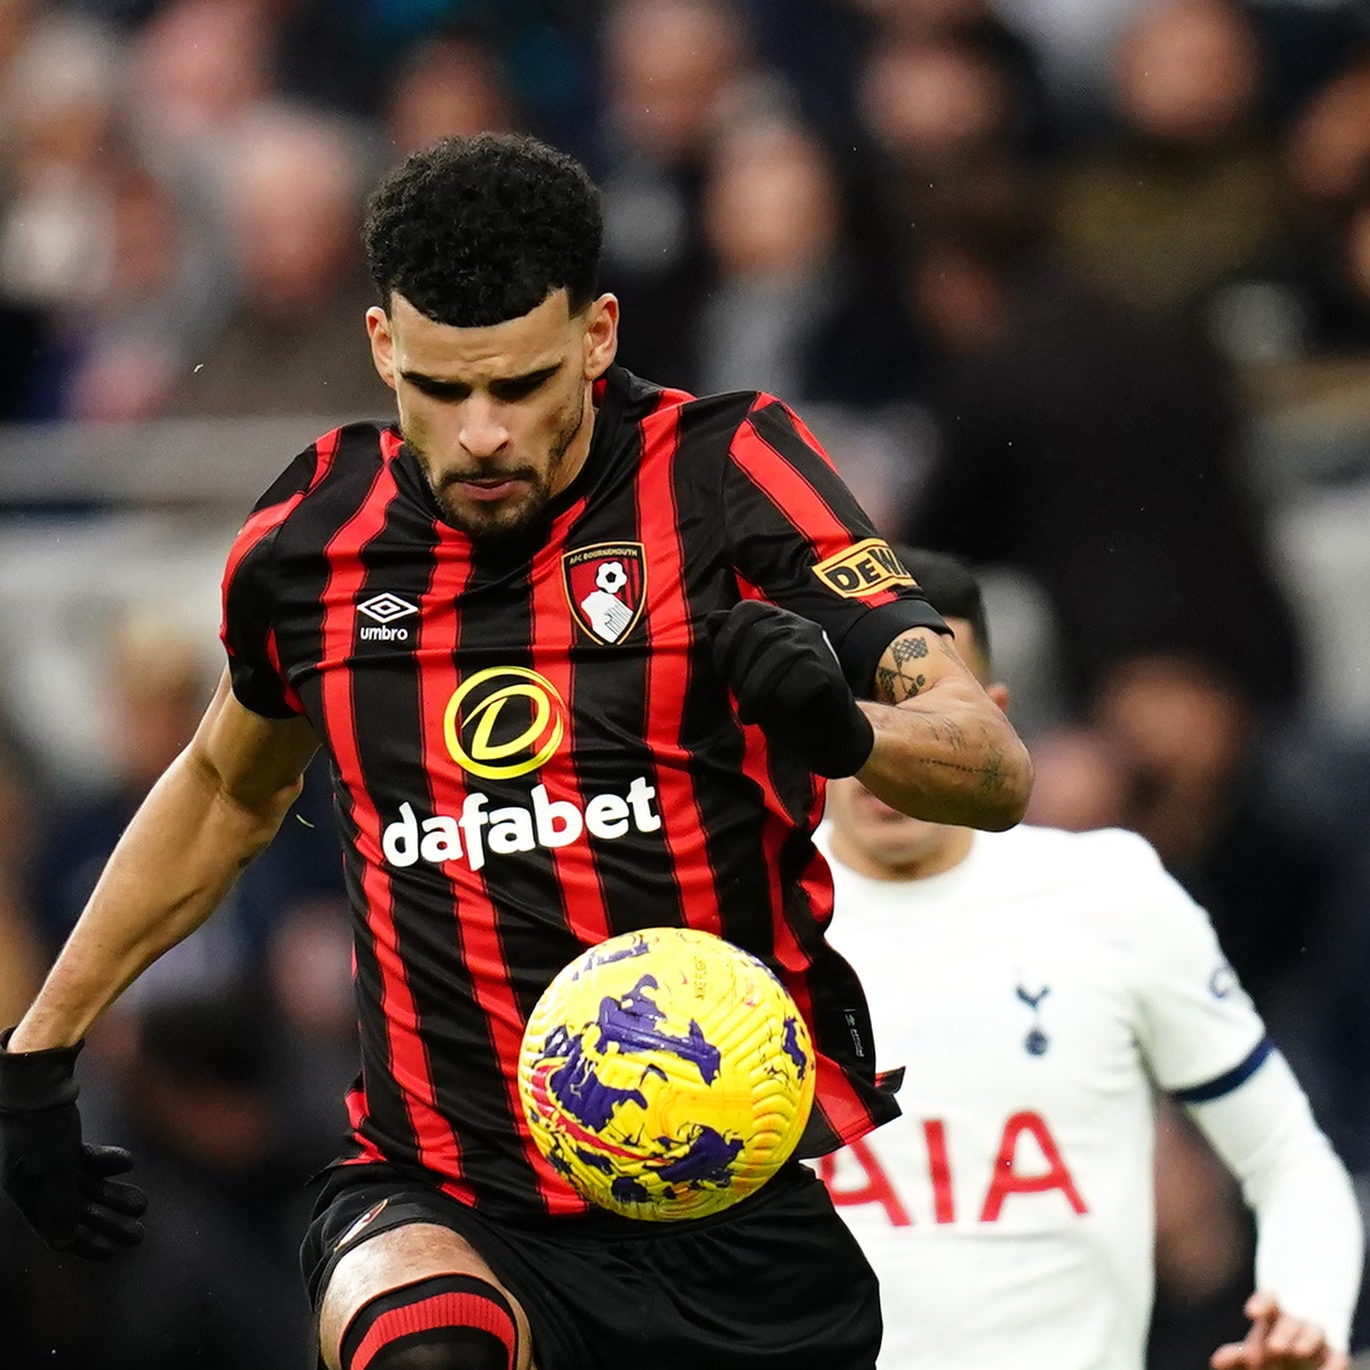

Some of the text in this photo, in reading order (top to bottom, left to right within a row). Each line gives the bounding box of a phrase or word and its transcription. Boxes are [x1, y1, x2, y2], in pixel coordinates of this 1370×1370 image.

[360, 625, 408, 641] umbro
[383, 776, 661, 872] dafabet
[820, 1111, 1088, 1226] AIA
